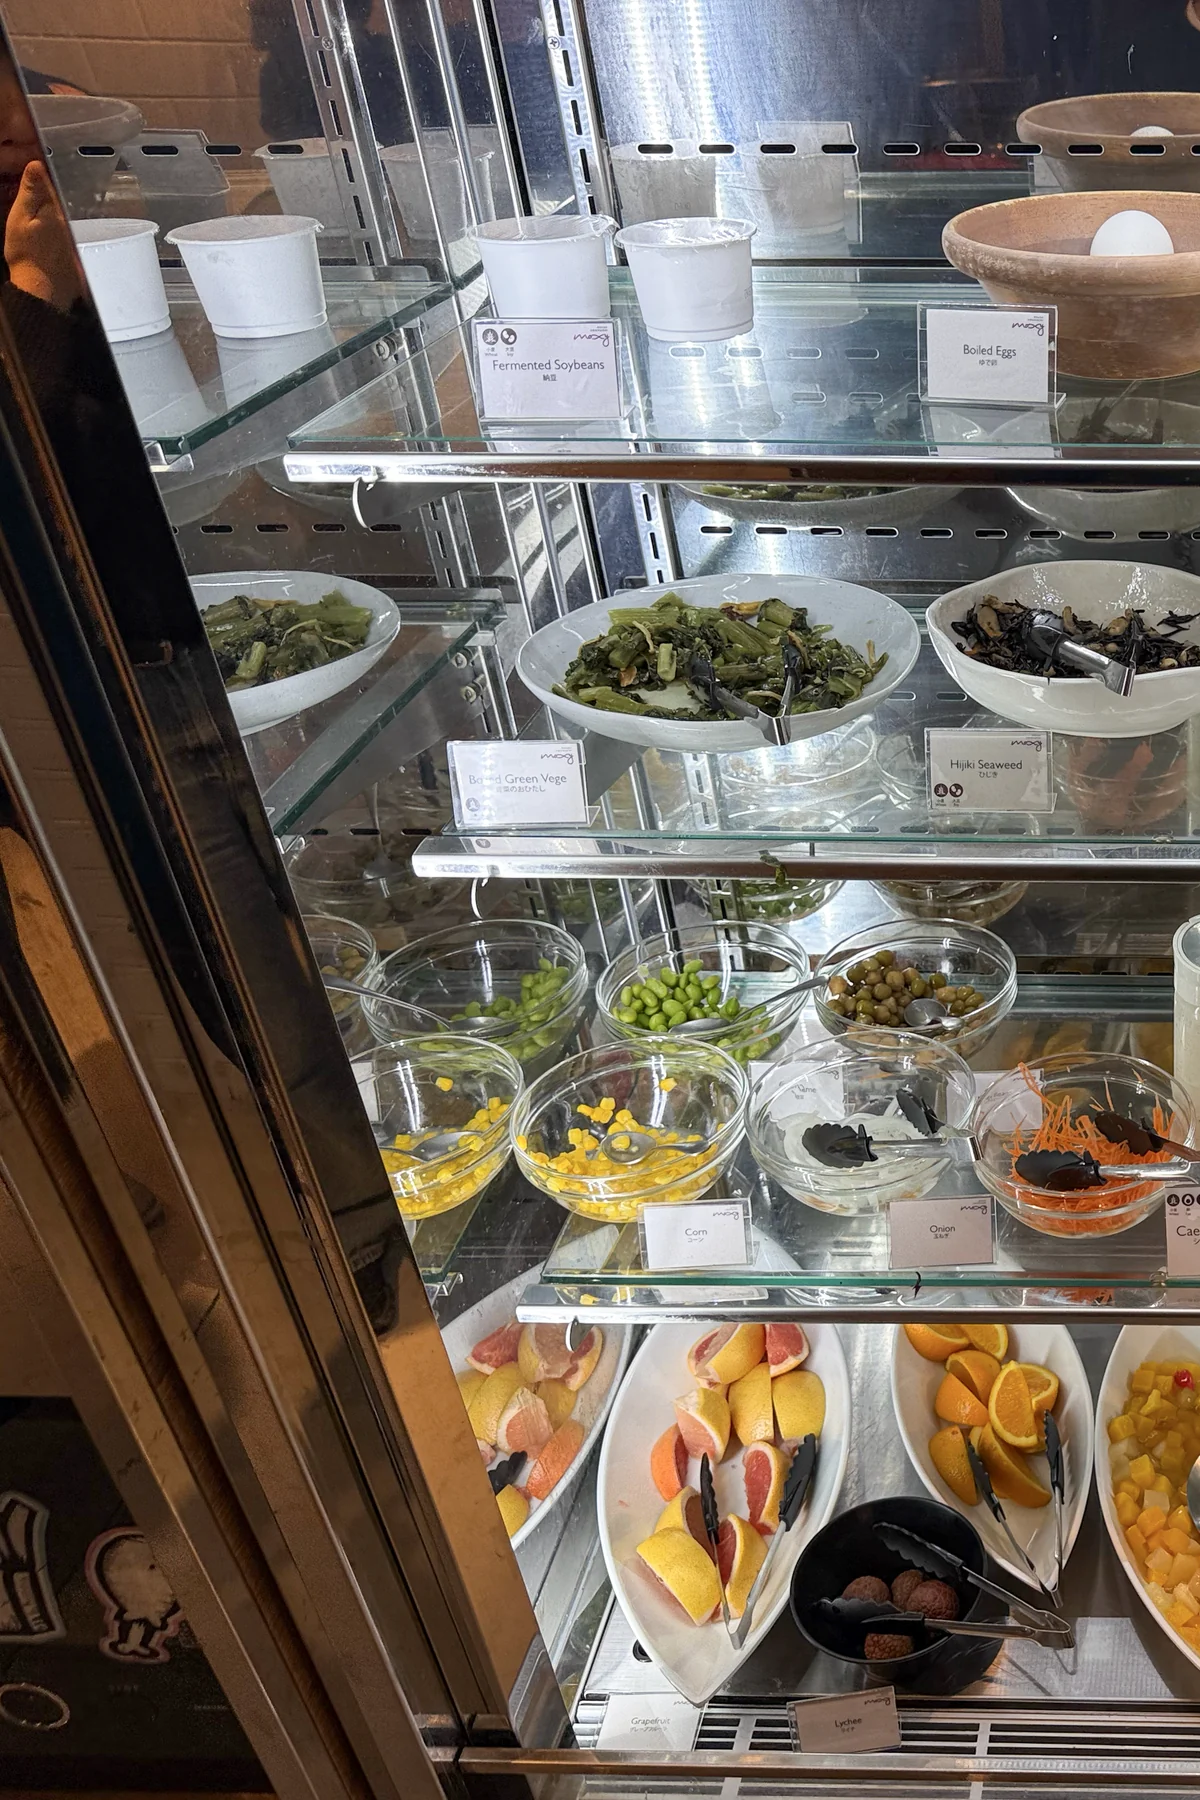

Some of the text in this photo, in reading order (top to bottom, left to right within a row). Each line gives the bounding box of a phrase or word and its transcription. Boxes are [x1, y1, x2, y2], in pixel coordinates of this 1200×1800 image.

[963, 344, 1017, 359] Boiled Eggs
[492, 359, 605, 374] Fermented Soybeans
[950, 759, 1023, 771] Hijiki Seaweed
[504, 773, 538, 784] Green
[540, 773, 567, 785] Vege
[685, 1228, 708, 1236] Corn
[930, 1225, 955, 1233] Onion
[631, 1716, 671, 1726] Grapefruit
[834, 1718, 862, 1728] Lychee
